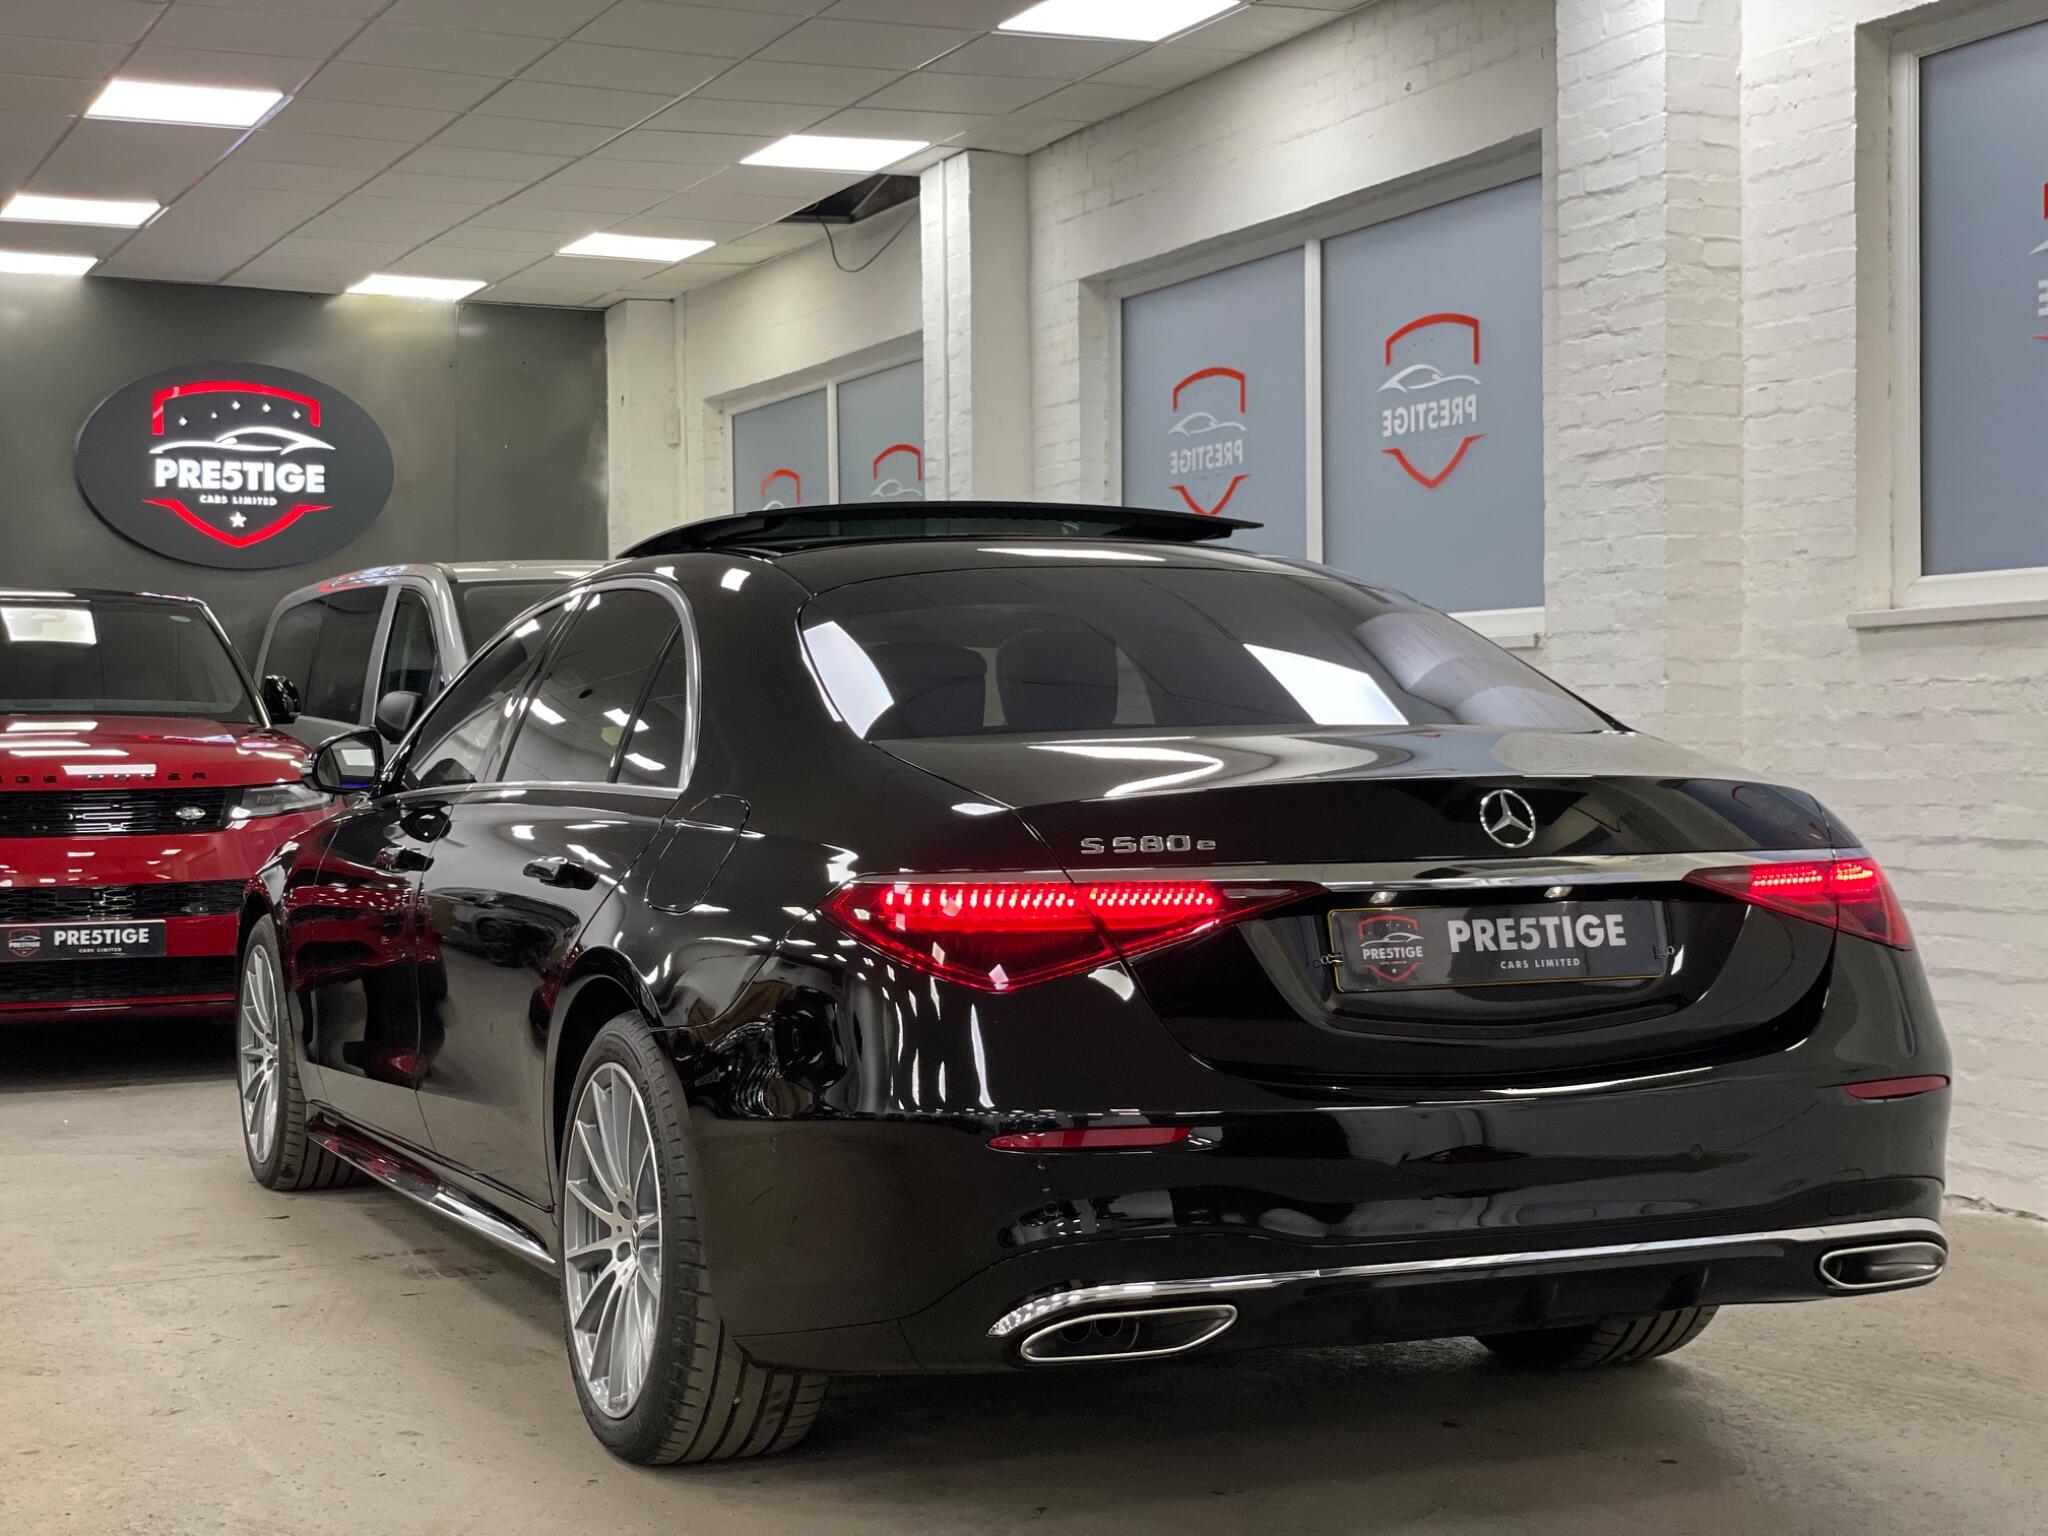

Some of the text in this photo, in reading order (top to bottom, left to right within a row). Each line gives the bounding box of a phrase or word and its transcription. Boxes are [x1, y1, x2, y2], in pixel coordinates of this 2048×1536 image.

[199, 494, 278, 506] CARS LIMITED
[1500, 958, 1580, 969] CARS LIMITED
